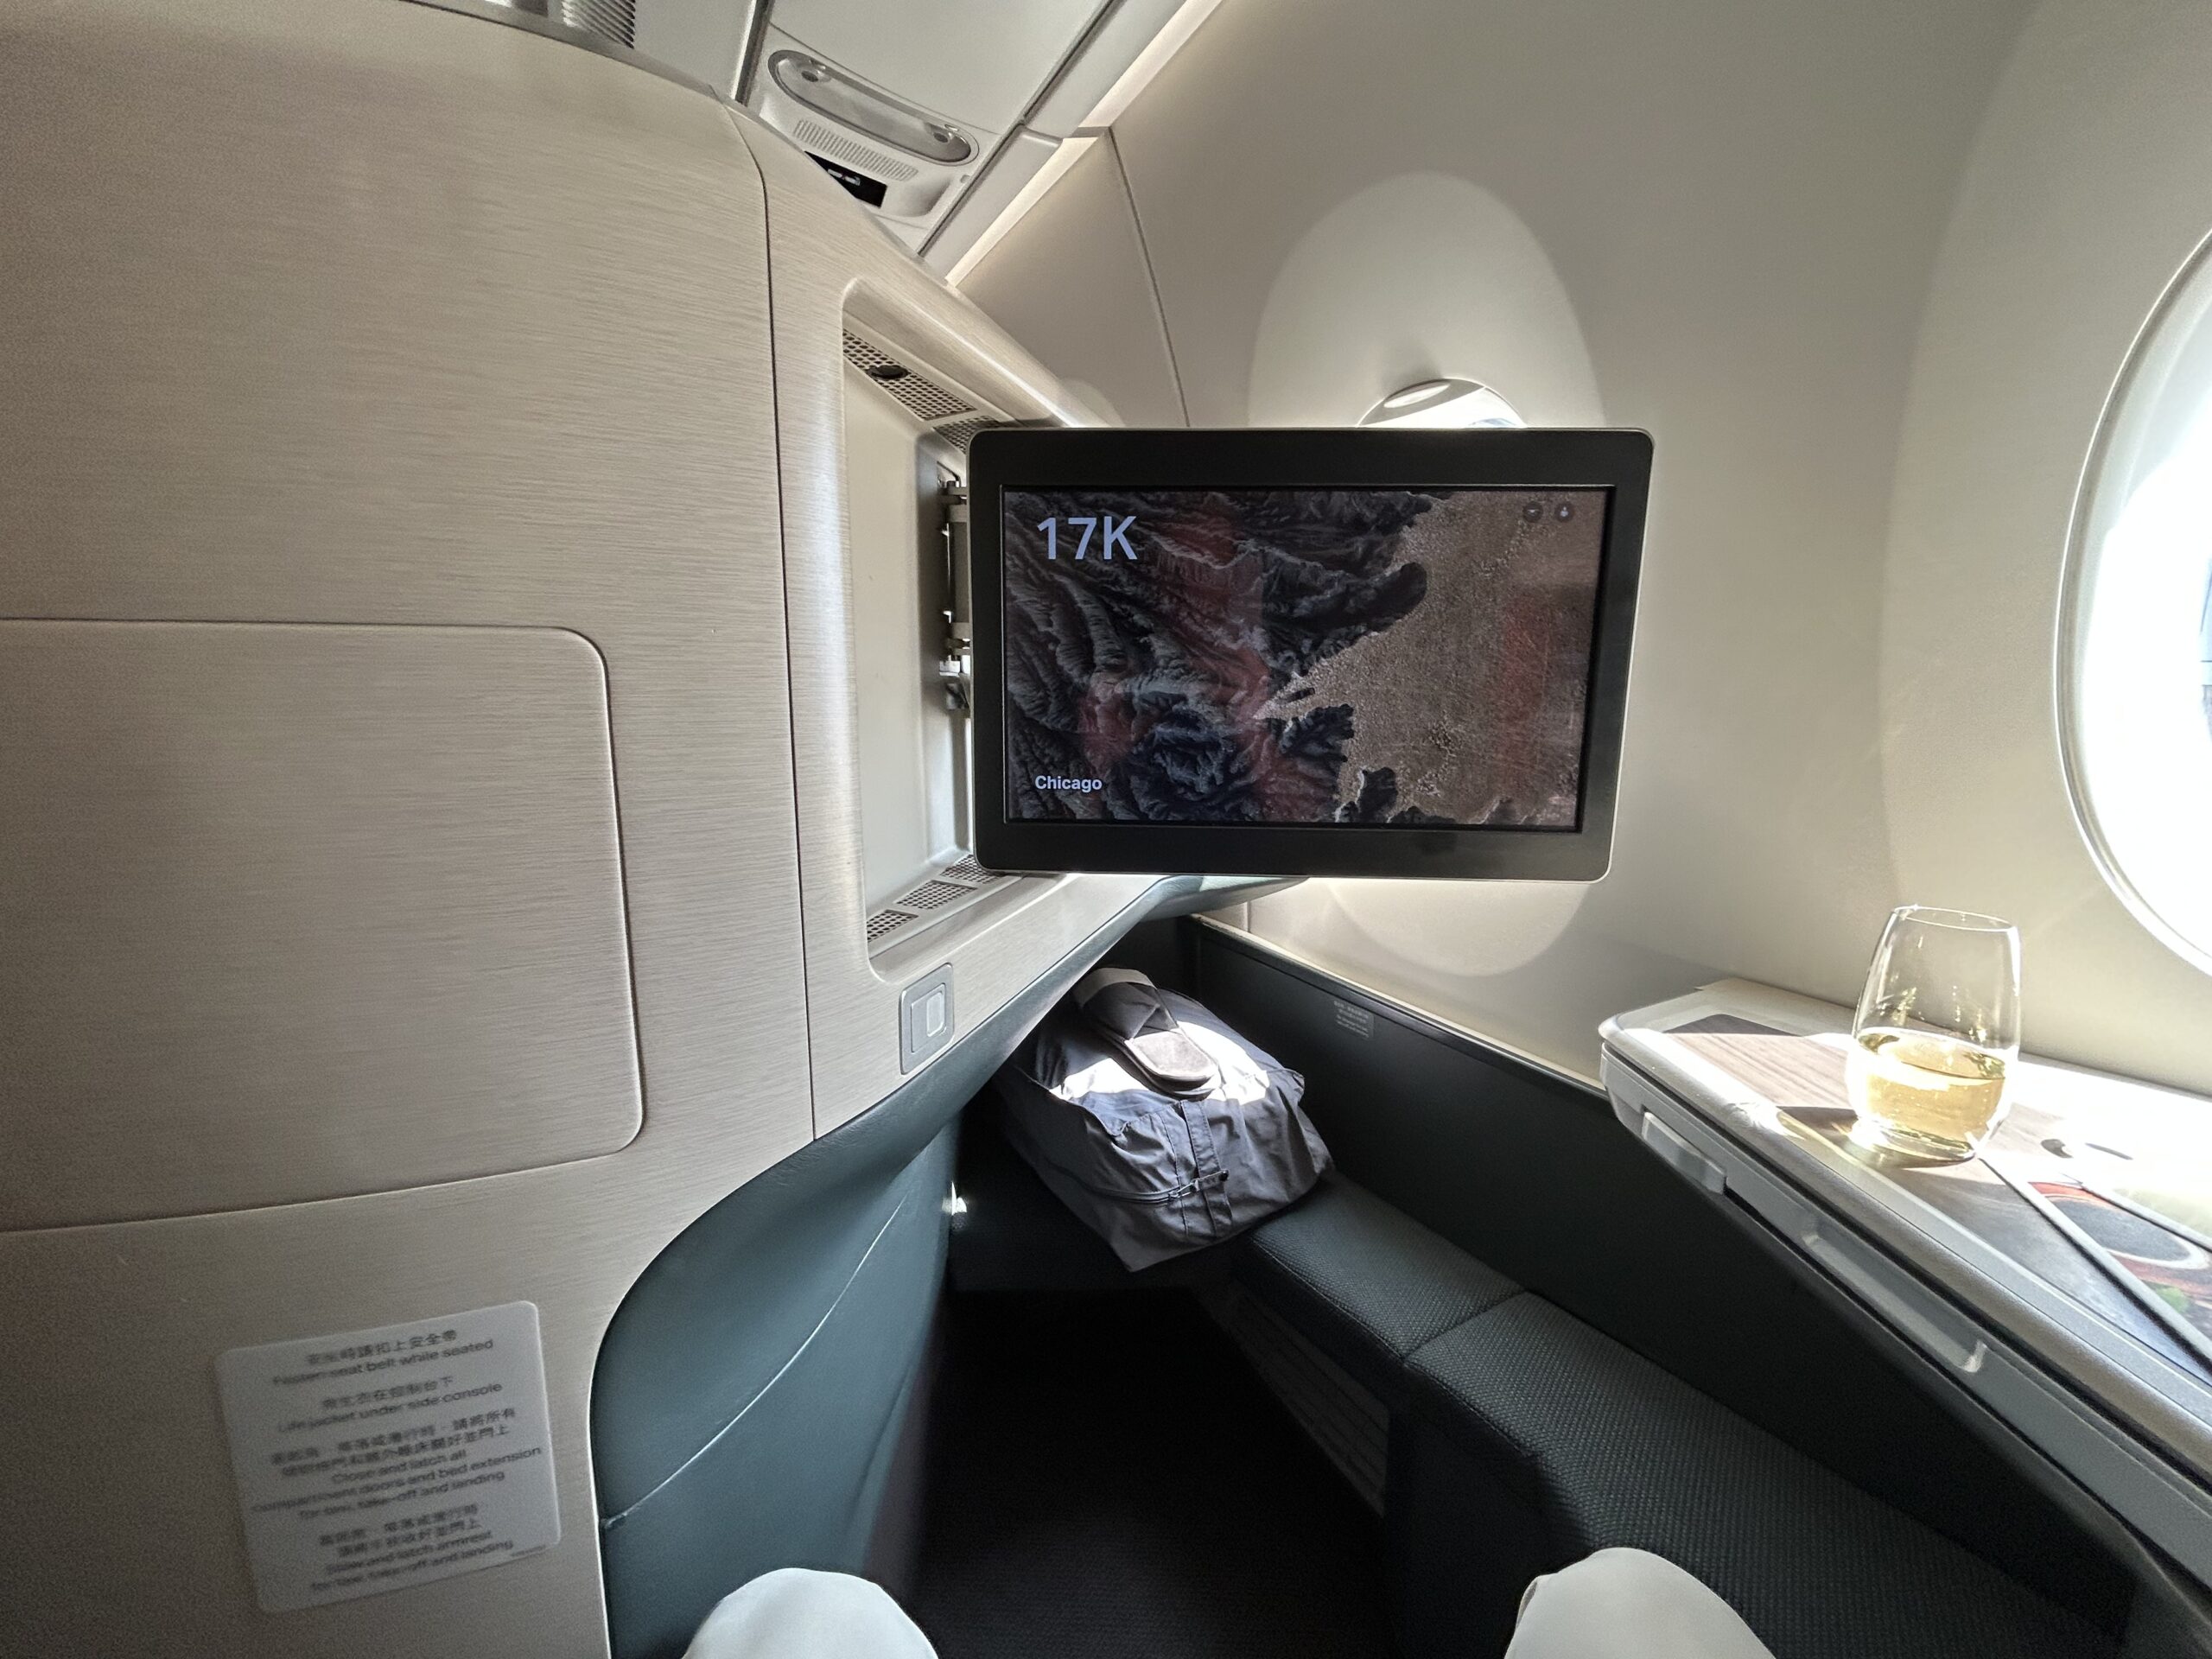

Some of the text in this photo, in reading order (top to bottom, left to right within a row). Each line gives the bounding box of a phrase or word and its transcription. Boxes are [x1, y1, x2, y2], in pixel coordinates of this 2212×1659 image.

[1036, 515, 1139, 561] 17K
[1034, 774, 1103, 793] Chicago
[366, 1357, 396, 1373] belt
[399, 1351, 439, 1366] while
[442, 1338, 494, 1358] seated
[359, 1403, 403, 1419] under
[408, 1395, 440, 1409] side
[442, 1382, 503, 1403] console
[359, 1478, 404, 1495] doors
[408, 1471, 436, 1485] and
[439, 1463, 468, 1479] bed
[470, 1446, 543, 1472] extension
[378, 1461, 407, 1478] and
[410, 1454, 448, 1470] latch
[449, 1448, 467, 1462] all
[420, 1482, 449, 1497] and
[451, 1470, 506, 1491] landing
[431, 1552, 460, 1567] and
[461, 1538, 515, 1560] landing
